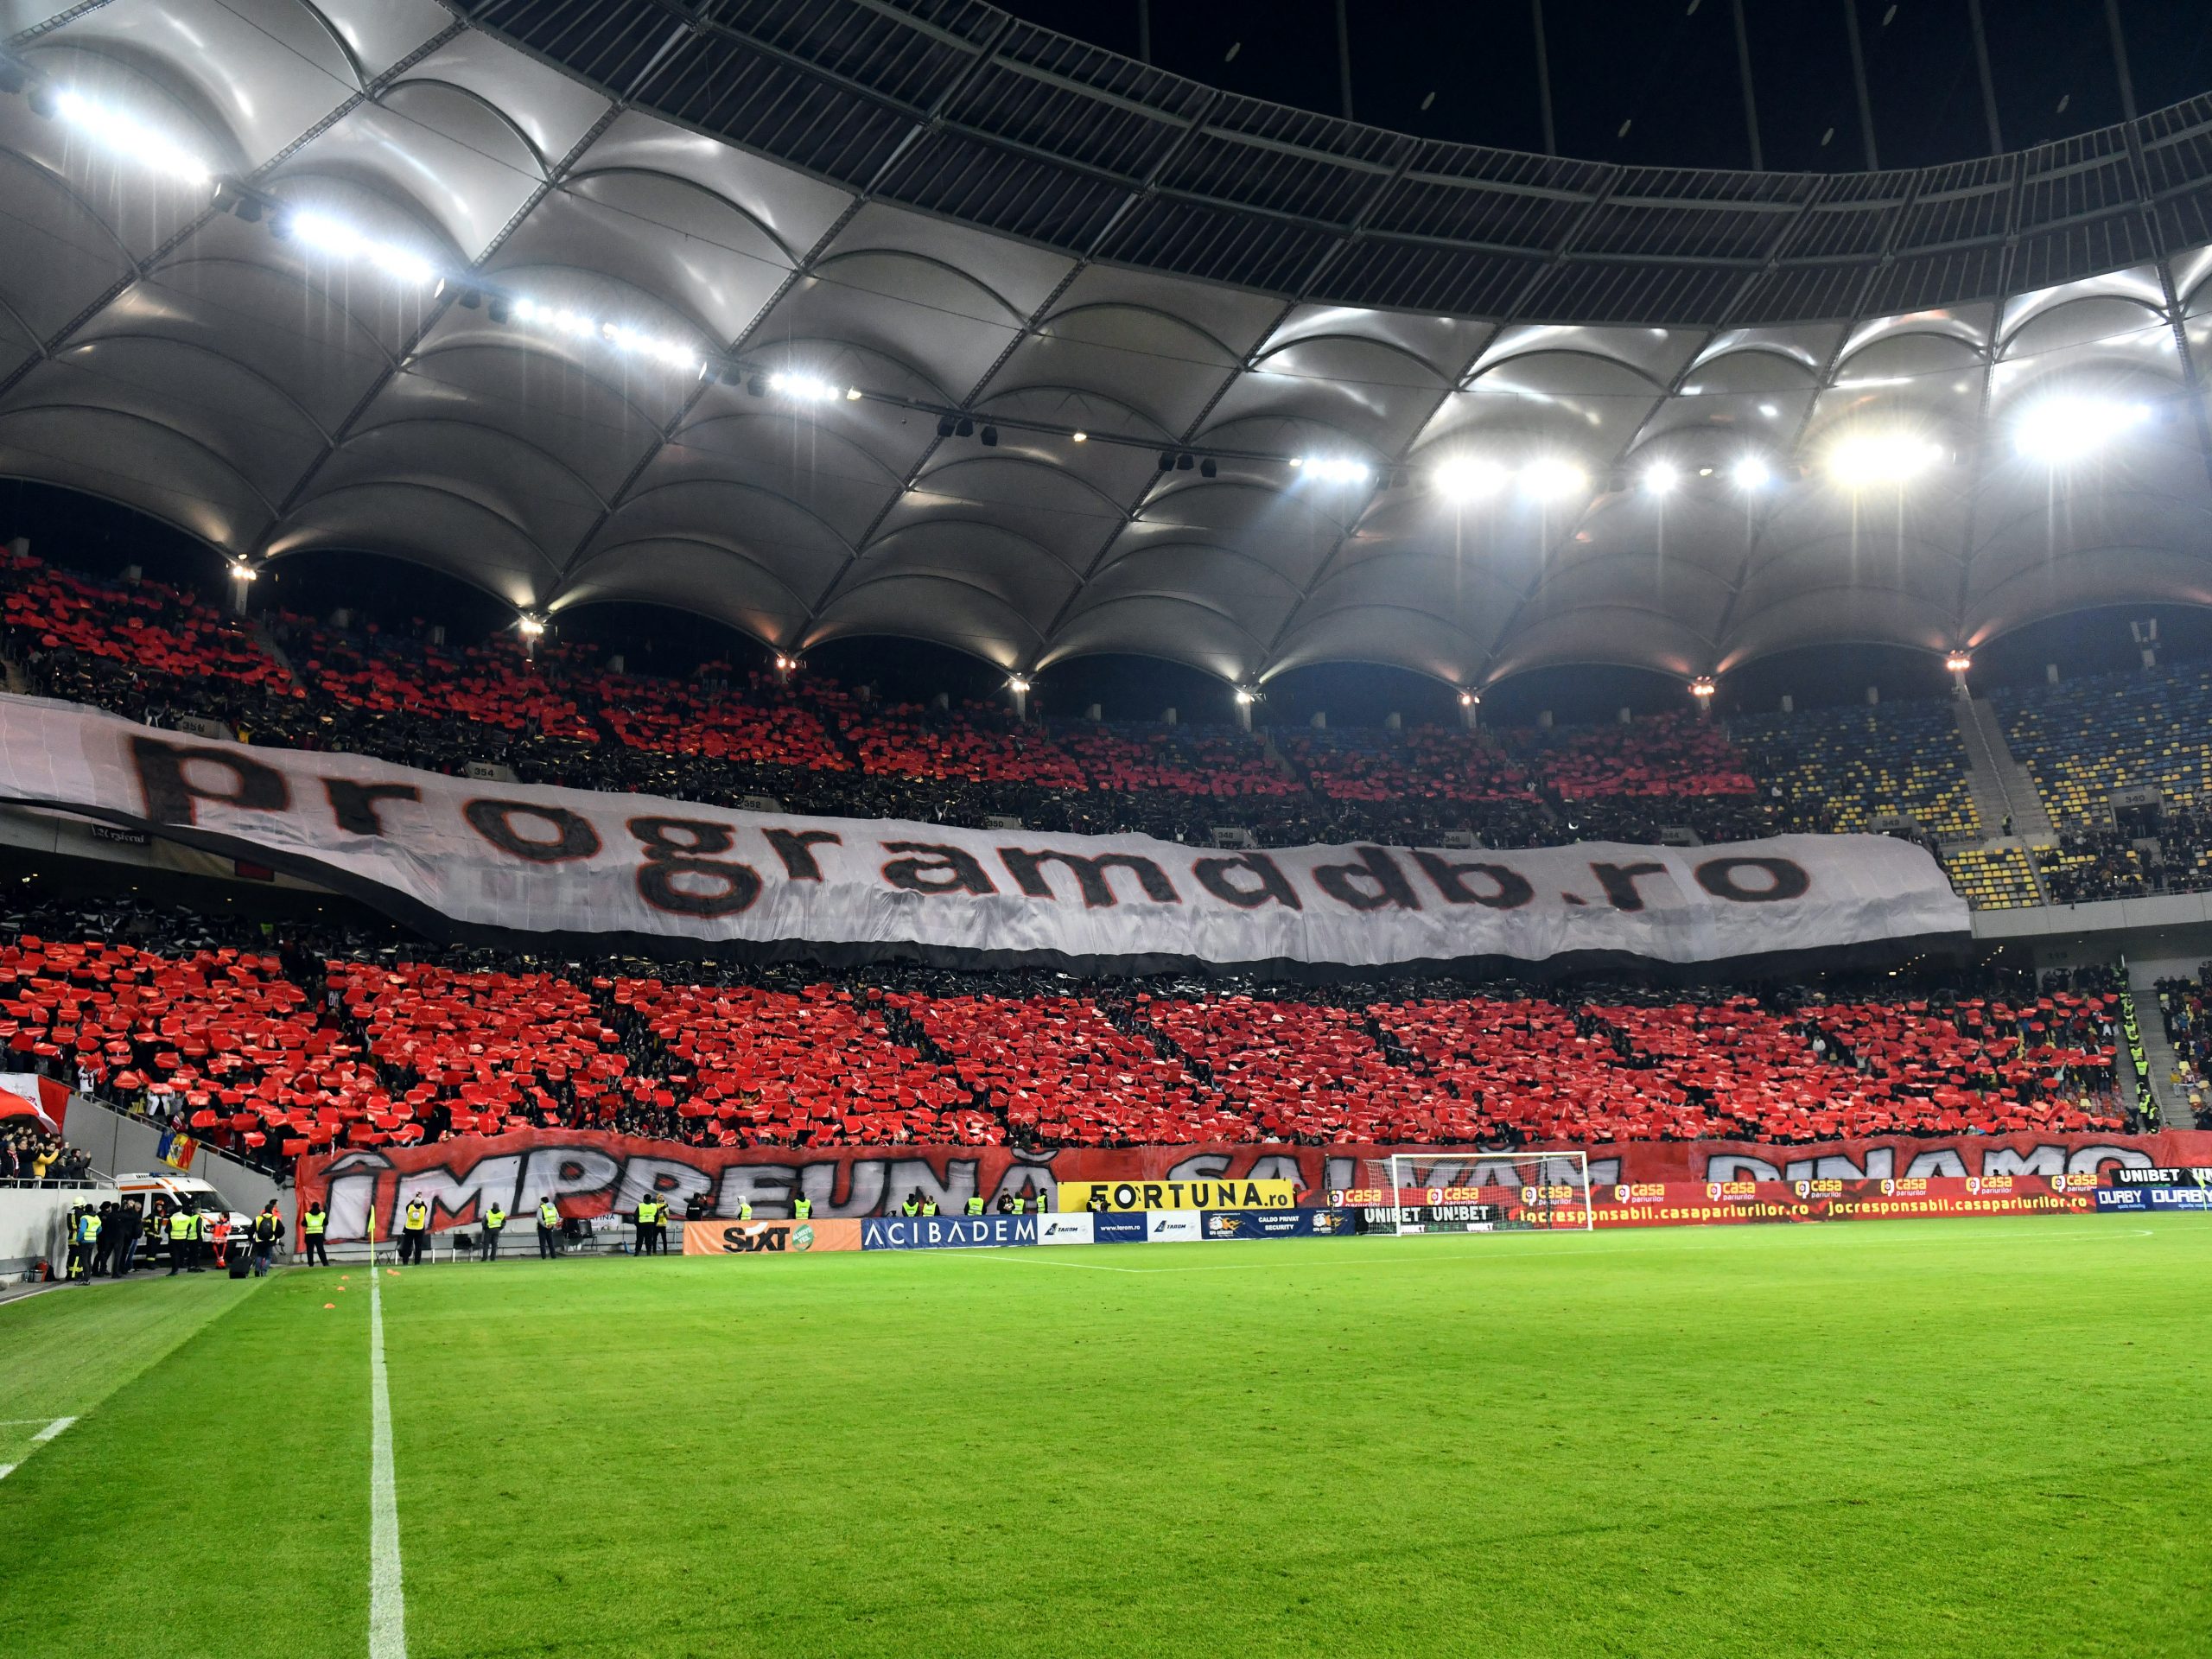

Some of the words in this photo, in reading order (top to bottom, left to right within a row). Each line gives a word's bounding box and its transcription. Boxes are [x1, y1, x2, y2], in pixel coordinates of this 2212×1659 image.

[474, 767, 494, 777] 354
[127, 734, 1811, 918] programadb.ro
[1981, 1176, 2012, 1188] casa
[2067, 1174, 2098, 1186] casa
[2119, 1169, 2180, 1183] UNIBET
[1630, 1184, 1665, 1196] casa
[1722, 1182, 1756, 1194] casa
[1810, 1179, 1842, 1192] casa
[1896, 1179, 1927, 1190] casa
[1345, 1189, 1382, 1202] casa
[1444, 1187, 1479, 1200] casa
[1538, 1186, 1573, 1198] casa
[2098, 1190, 2142, 1205] DURBY
[1828, 1196, 2087, 1217] jocresponsabil.casapariurilor.ro
[864, 1219, 1036, 1246] ACIBADEM
